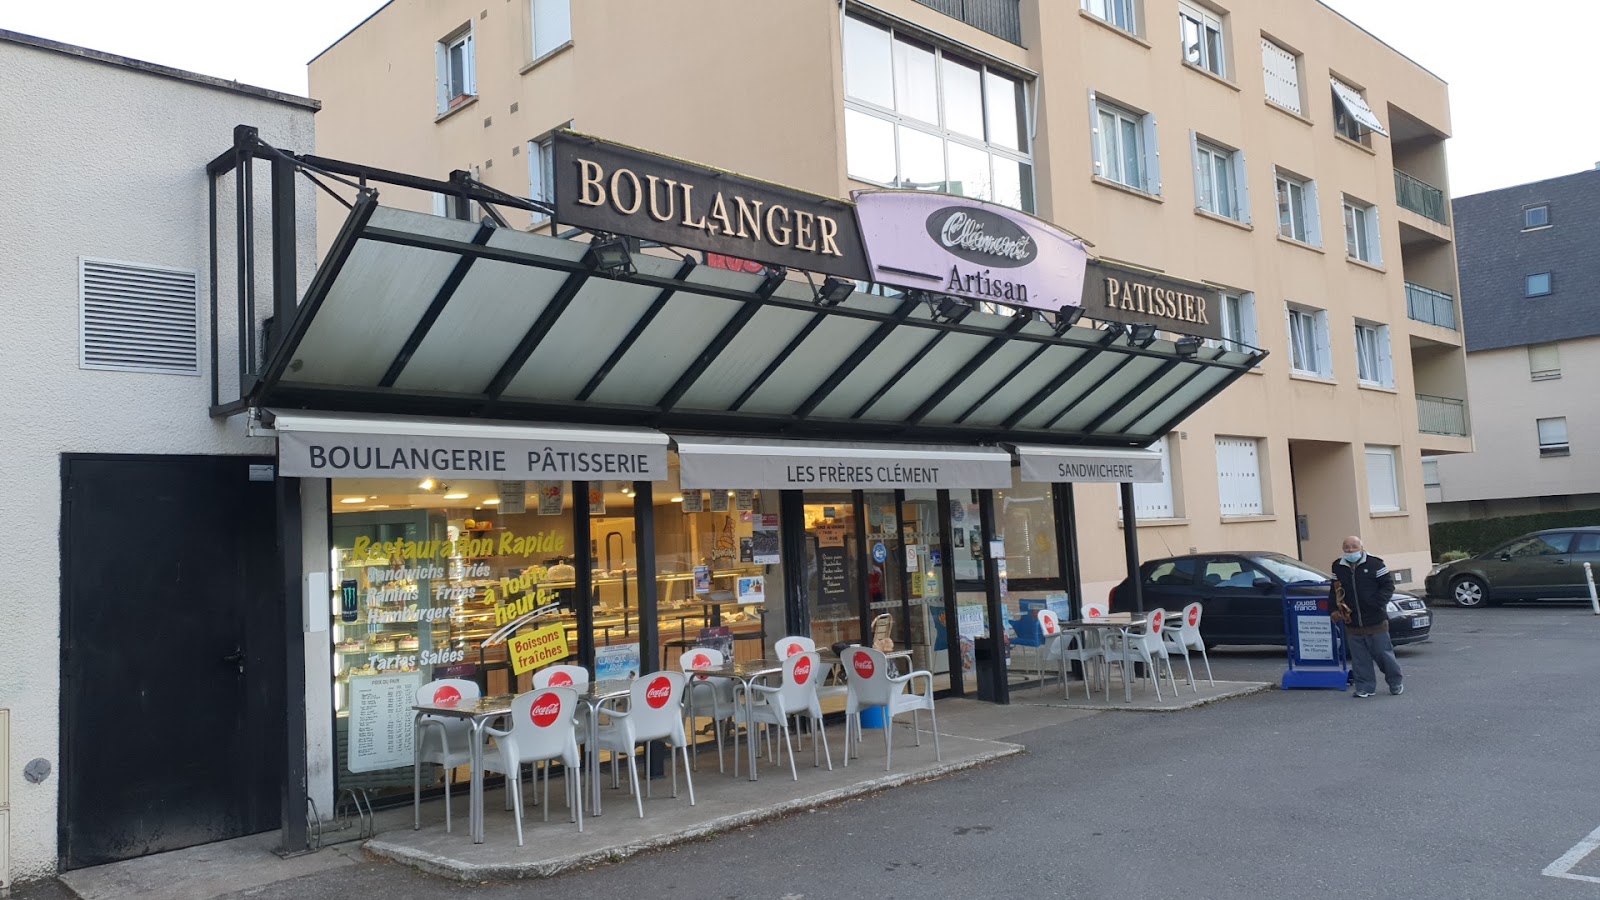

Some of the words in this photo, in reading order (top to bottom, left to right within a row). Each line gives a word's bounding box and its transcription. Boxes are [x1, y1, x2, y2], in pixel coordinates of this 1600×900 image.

[577, 158, 843, 257] BOULANGER
[947, 264, 1029, 302] Artisan
[1106, 276, 1210, 325] PATISSIER
[309, 445, 506, 472] BOULANGERIE
[527, 447, 649, 473] PÂTISSERIE
[1058, 463, 1133, 478] SANDWICHERIE
[787, 465, 815, 483] LES
[819, 461, 874, 483] FRÈRES
[877, 463, 939, 484] CLÉMENT
[495, 530, 565, 558] Rapide
[436, 585, 476, 600] Frites
[368, 604, 457, 624] Hamburgers
[514, 630, 560, 654] Boissons
[368, 653, 416, 671] Tartes
[420, 649, 464, 666] Salées
[517, 644, 562, 670] fraîches
